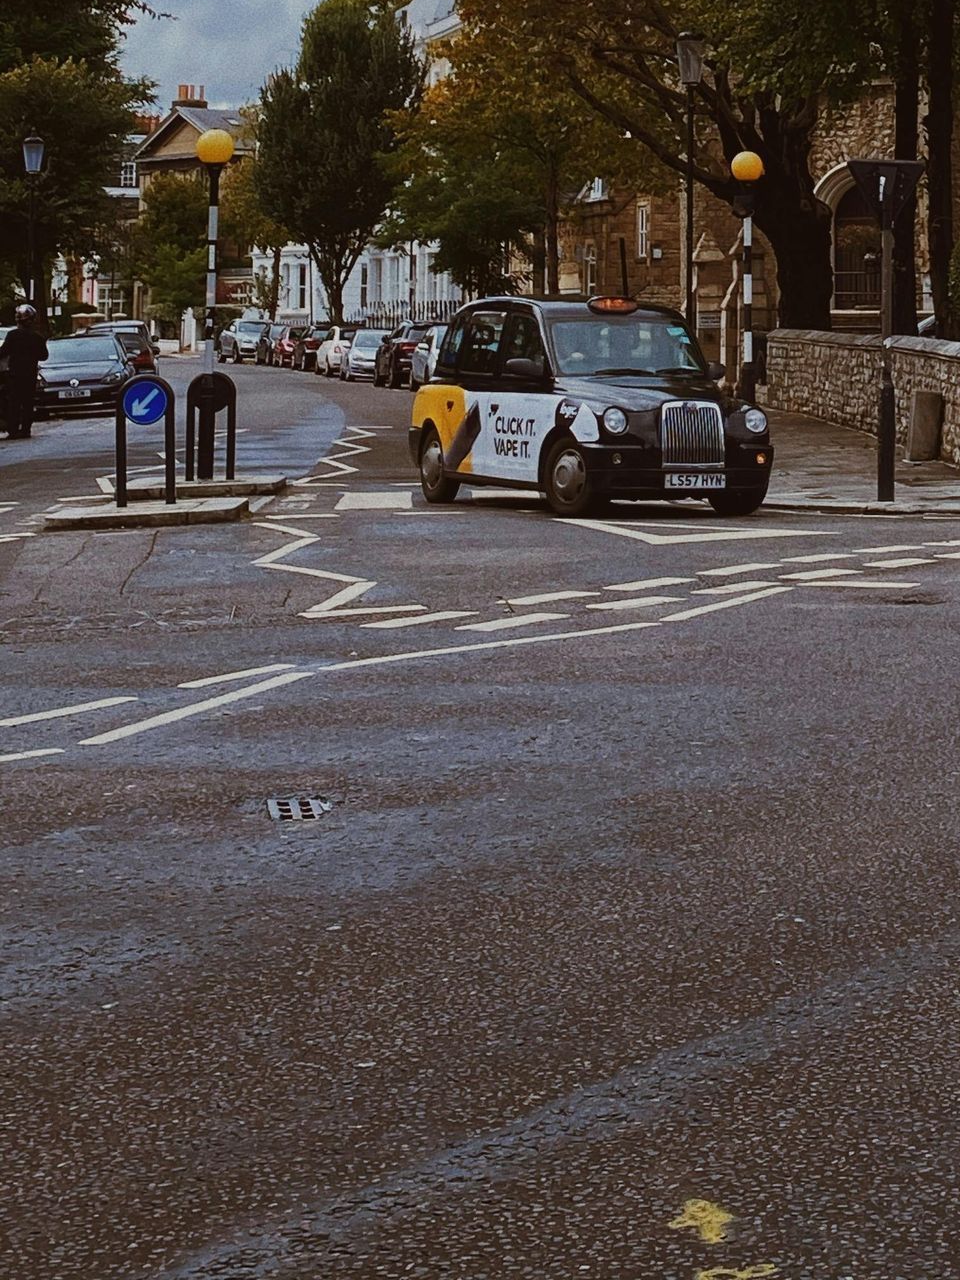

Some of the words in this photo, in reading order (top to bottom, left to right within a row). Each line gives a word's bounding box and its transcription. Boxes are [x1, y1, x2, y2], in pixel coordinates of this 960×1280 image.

[495, 415, 524, 436] CLICK
[525, 418, 537, 437] IT.
[494, 437, 519, 458] VAPE
[520, 440, 531, 459] IT.
[670, 474, 699, 487] LS57
[702, 474, 722, 487] HYN
